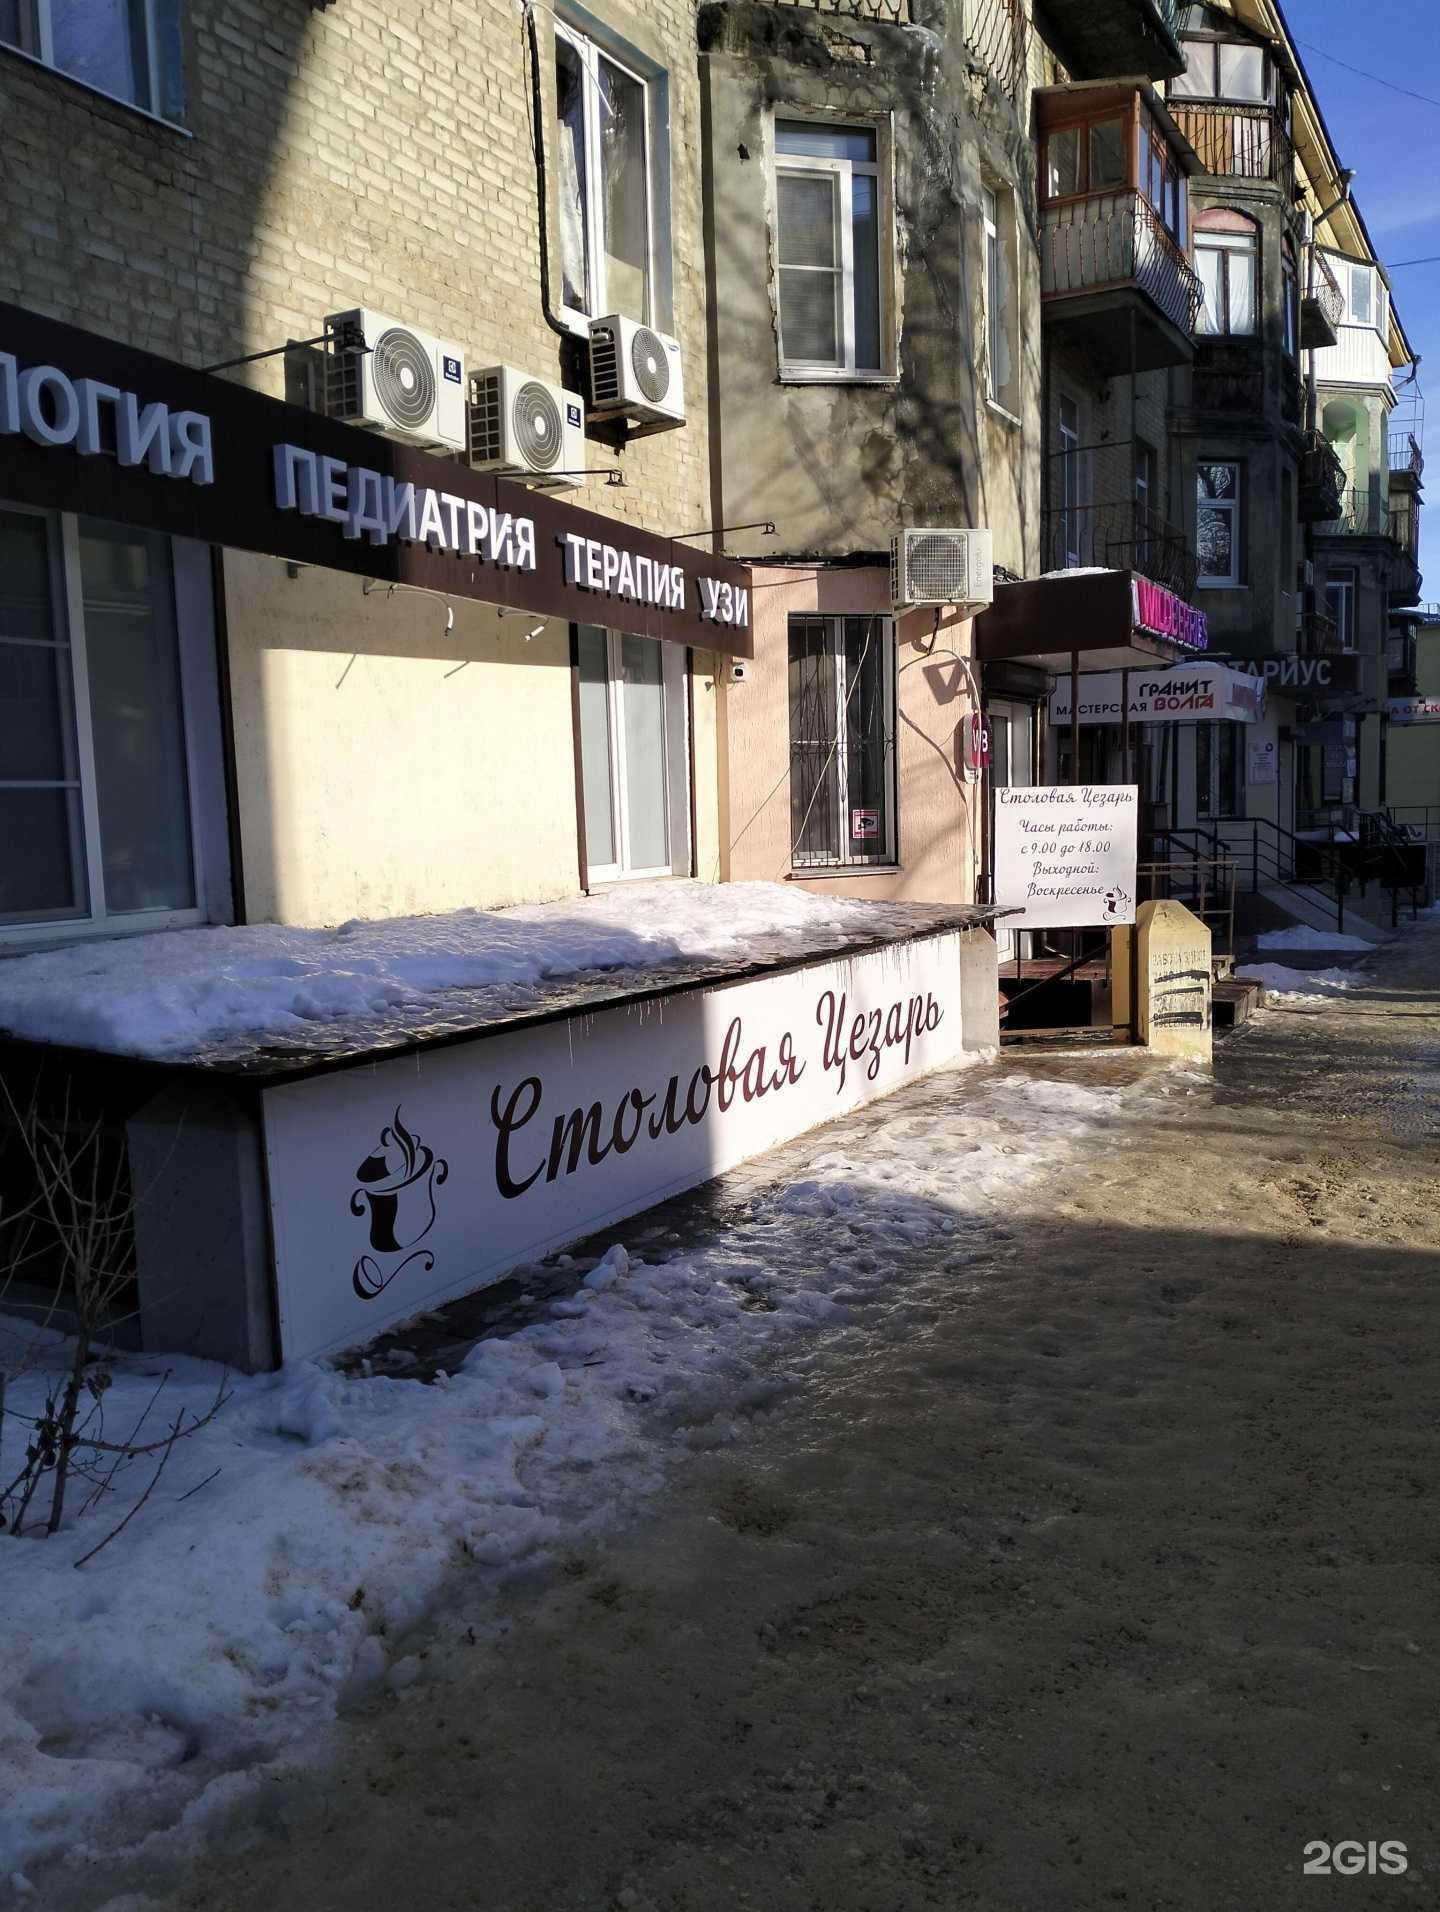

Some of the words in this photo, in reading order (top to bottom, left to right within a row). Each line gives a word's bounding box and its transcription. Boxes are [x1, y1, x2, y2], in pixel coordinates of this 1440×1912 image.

[273, 443, 536, 570] ПЕДИАТРИЯ
[559, 532, 685, 610] ТЕРАПИЯ
[701, 576, 749, 627] УЗИ
[1226, 658, 1333, 687] ТАРИУС
[1138, 678, 1213, 697] ГРАНИТ
[1056, 702, 1148, 716] МСТЕРСАЯ
[1153, 693, 1214, 711] ВОЛГА
[1000, 788, 1076, 804] Столовая
[1081, 787, 1133, 807] Цезарь
[1019, 819, 1055, 833] Часы
[1058, 818, 1113, 836] работы:
[1020, 845, 1029, 854] с
[1031, 842, 1057, 854] 9.00
[1060, 845, 1075, 857] до
[1078, 840, 1111, 853] 18.00
[1032, 861, 1100, 878] Выходной:
[1027, 882, 1105, 899] Воскресенье
[491, 1016, 806, 1199] Столовая
[815, 990, 944, 1092] Цезарь
